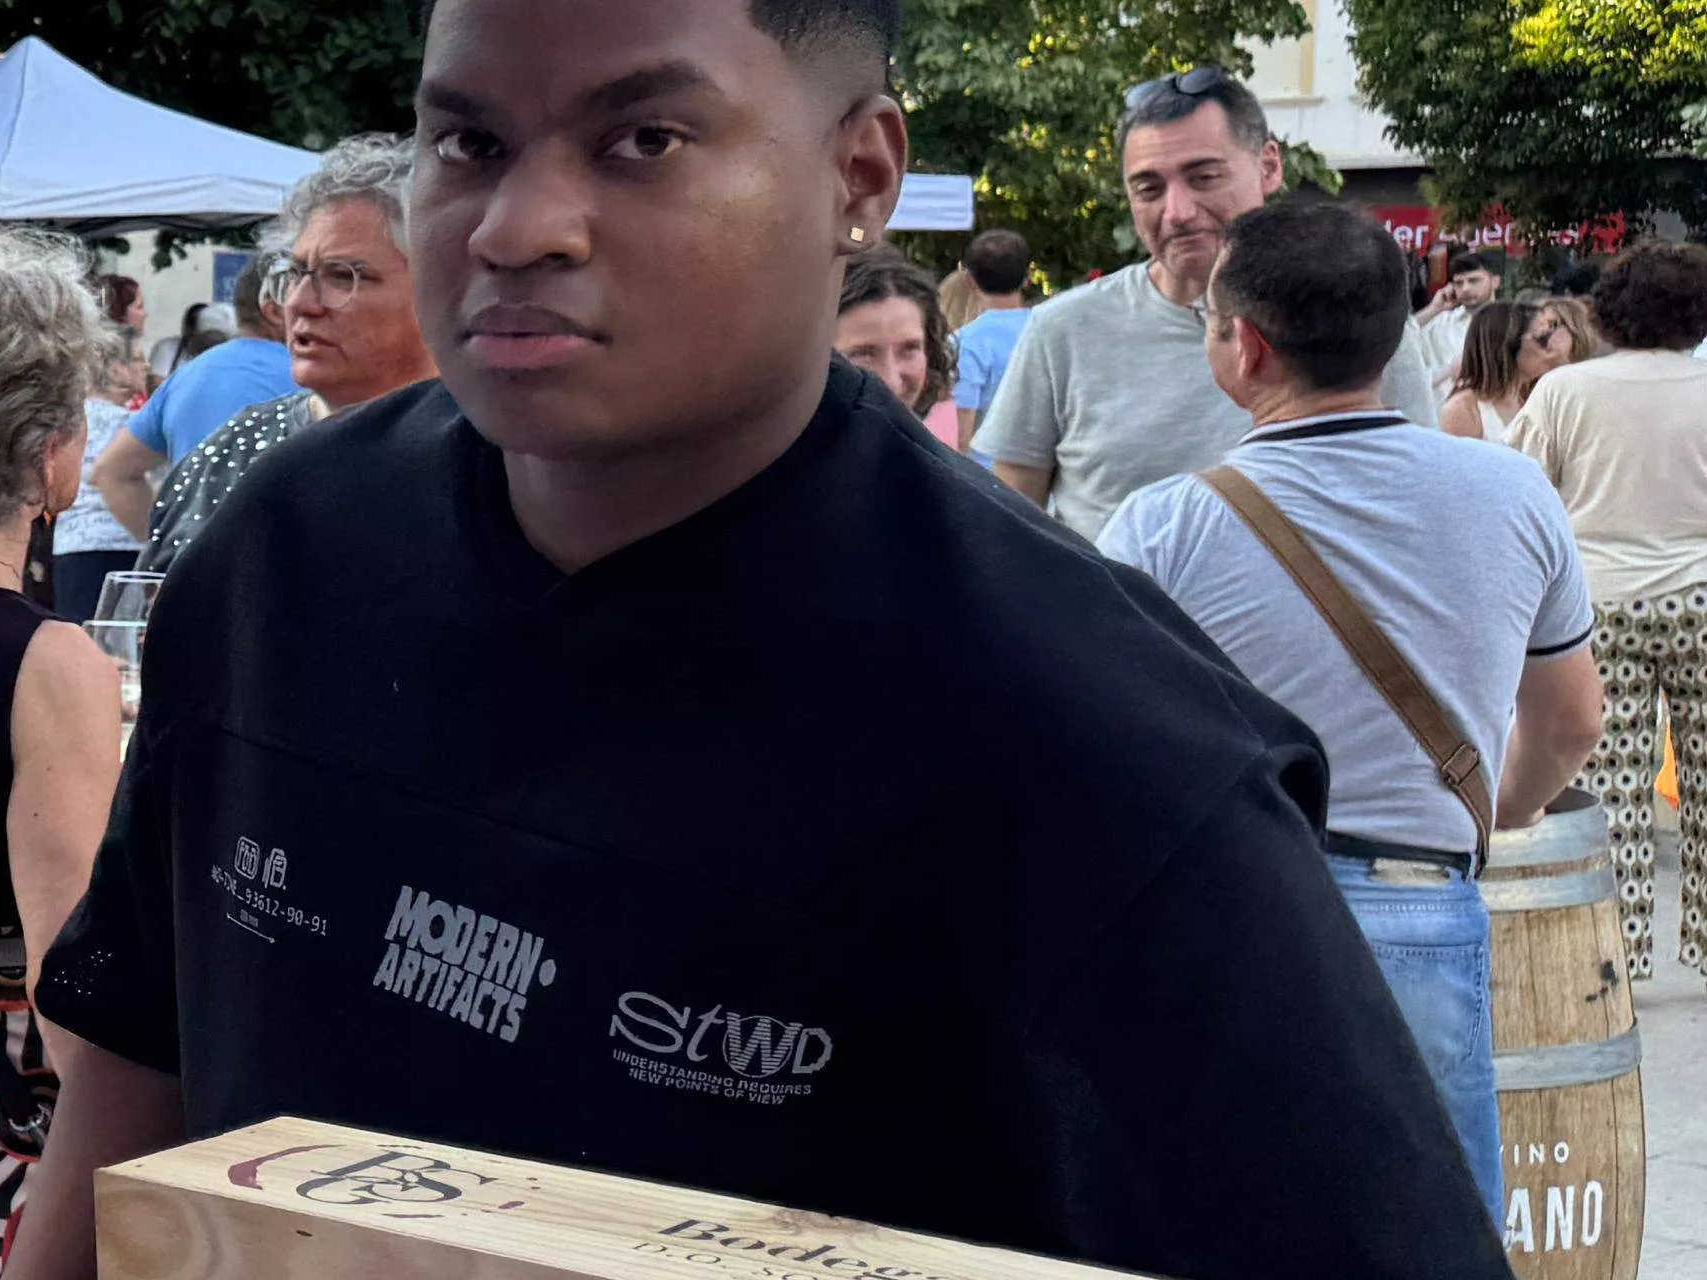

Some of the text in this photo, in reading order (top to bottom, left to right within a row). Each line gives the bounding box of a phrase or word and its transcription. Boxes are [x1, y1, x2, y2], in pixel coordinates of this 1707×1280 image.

[372, 942, 527, 1044] ARTIFACTS
[612, 1048, 813, 1096] UNDERSTANDING REQUIRES
[628, 1066, 786, 1106] NEW POINTS OF VIEW
[1499, 1140, 1570, 1167] INO
